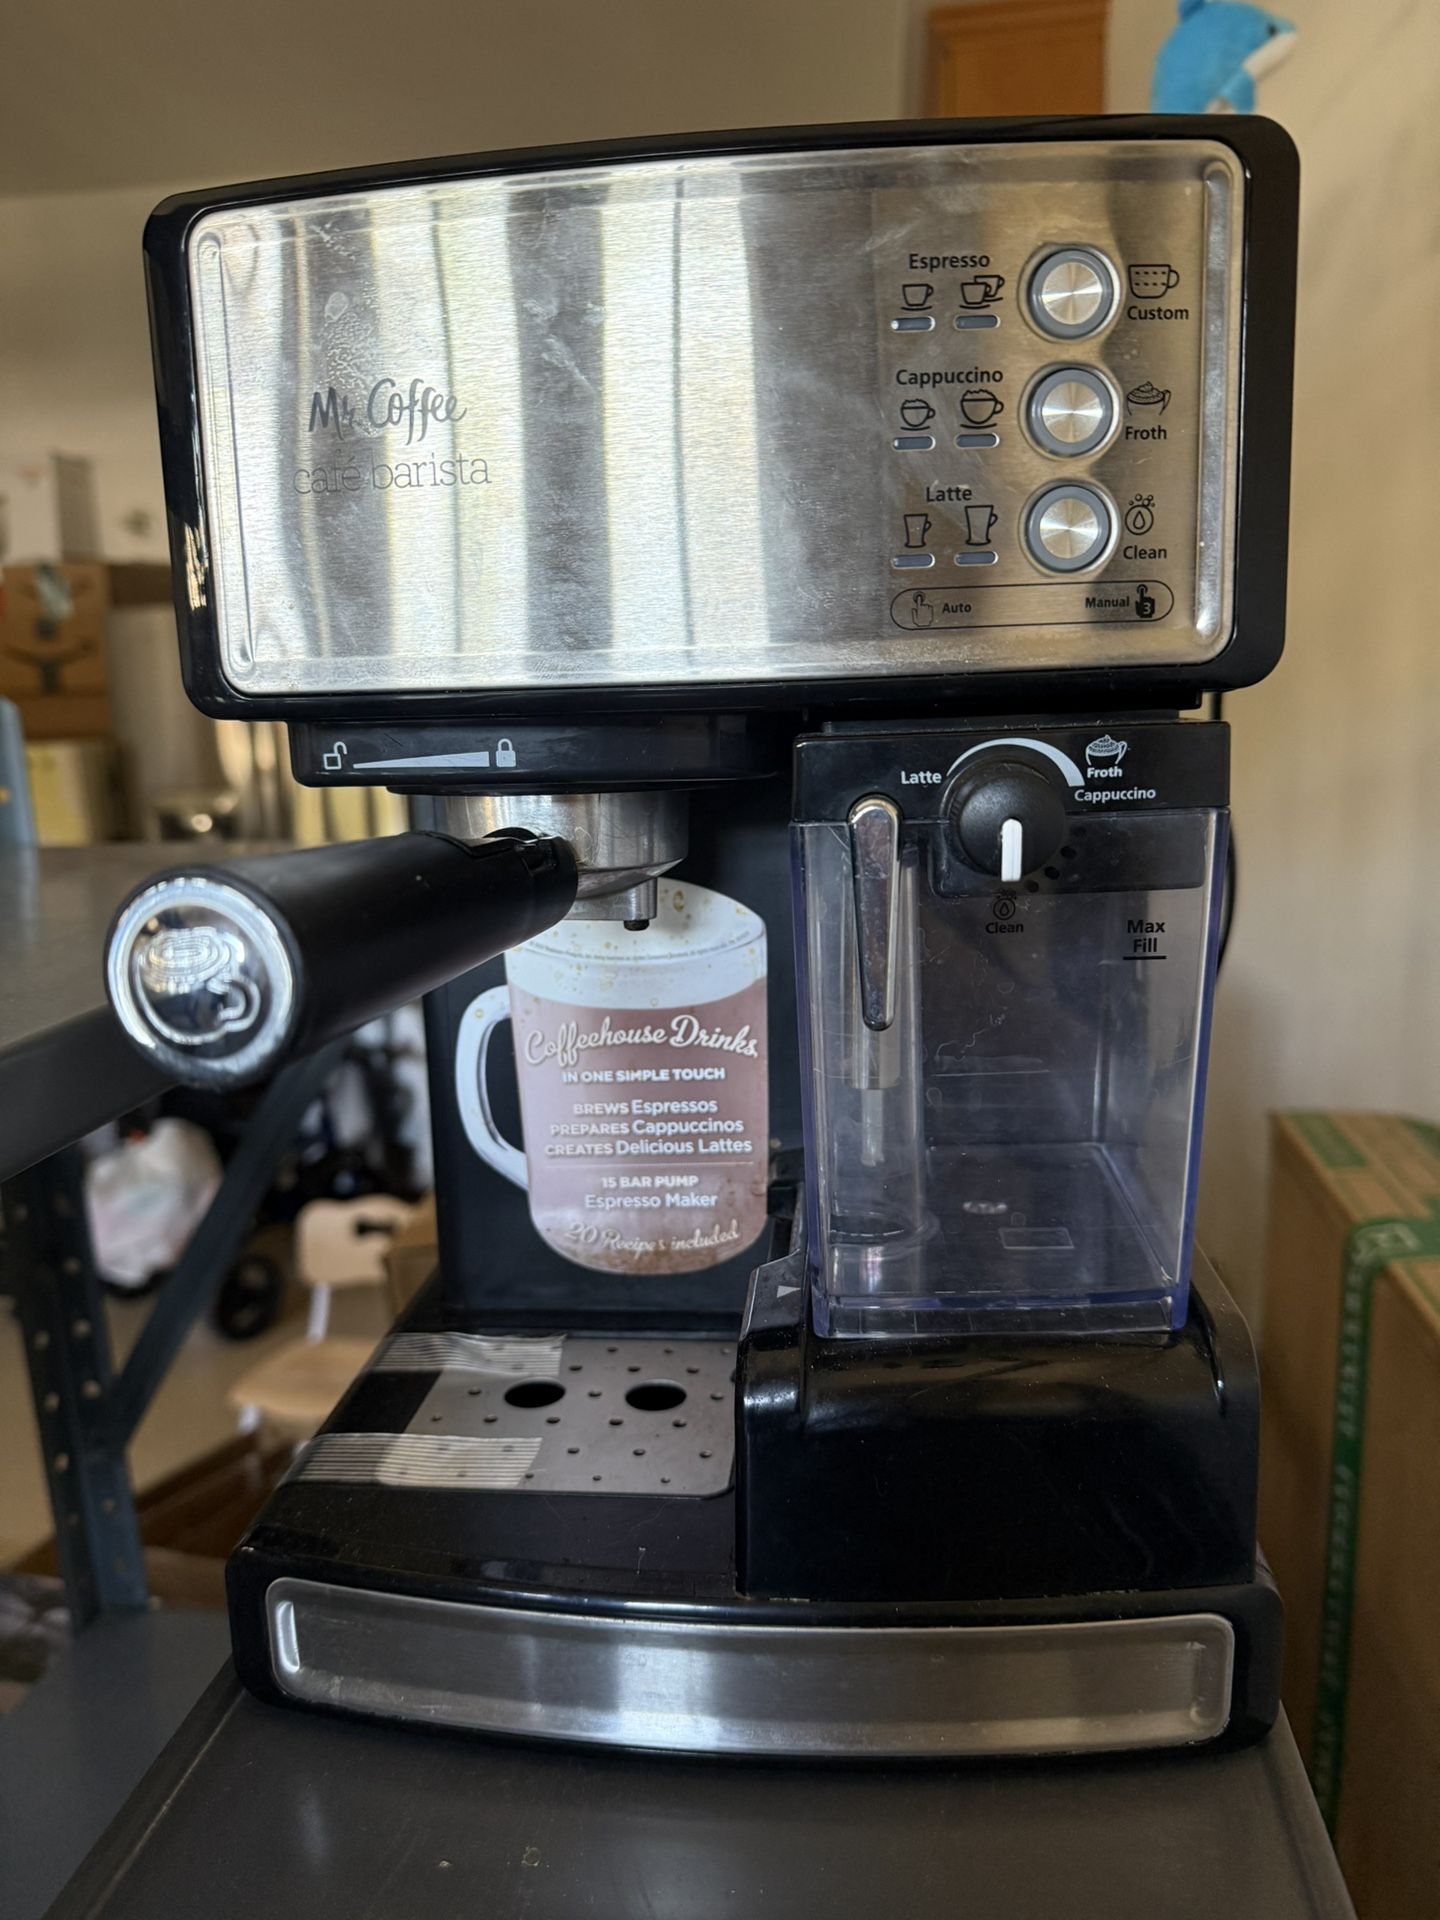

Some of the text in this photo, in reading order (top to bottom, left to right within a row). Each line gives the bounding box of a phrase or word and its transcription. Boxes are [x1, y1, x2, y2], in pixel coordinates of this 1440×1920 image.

[909, 253, 990, 273] Espresso
[1127, 305, 1190, 321] Custom
[896, 368, 1004, 389] Cappuccino
[367, 377, 468, 446] Coffee
[1125, 426, 1167, 441] Froth
[293, 448, 492, 495] café barista
[925, 486, 973, 503] Latte
[1123, 544, 1168, 561] Clean
[942, 602, 972, 614] Auto
[1085, 596, 1130, 610] Manual
[901, 770, 942, 785] Latte
[1086, 766, 1123, 779] Froth
[1074, 786, 1157, 804] Cappuccino
[985, 921, 1024, 934] Clean
[1127, 919, 1165, 934] Max
[1133, 937, 1158, 953] Fill
[524, 1014, 758, 1067] Coffeehouse Drinks
[562, 1067, 726, 1083] IN ONE SIMPLE TOUCH
[573, 1099, 718, 1117] BREWS Espressos
[551, 1117, 744, 1137] PREPARES Cappuccinos
[545, 1138, 753, 1157] CREATES Delicious Lattes
[602, 1175, 699, 1188] 15 BAR PUMP
[585, 1192, 718, 1211] Espresso Maker
[565, 1221, 598, 1244] 20
[671, 1218, 741, 1250] included
